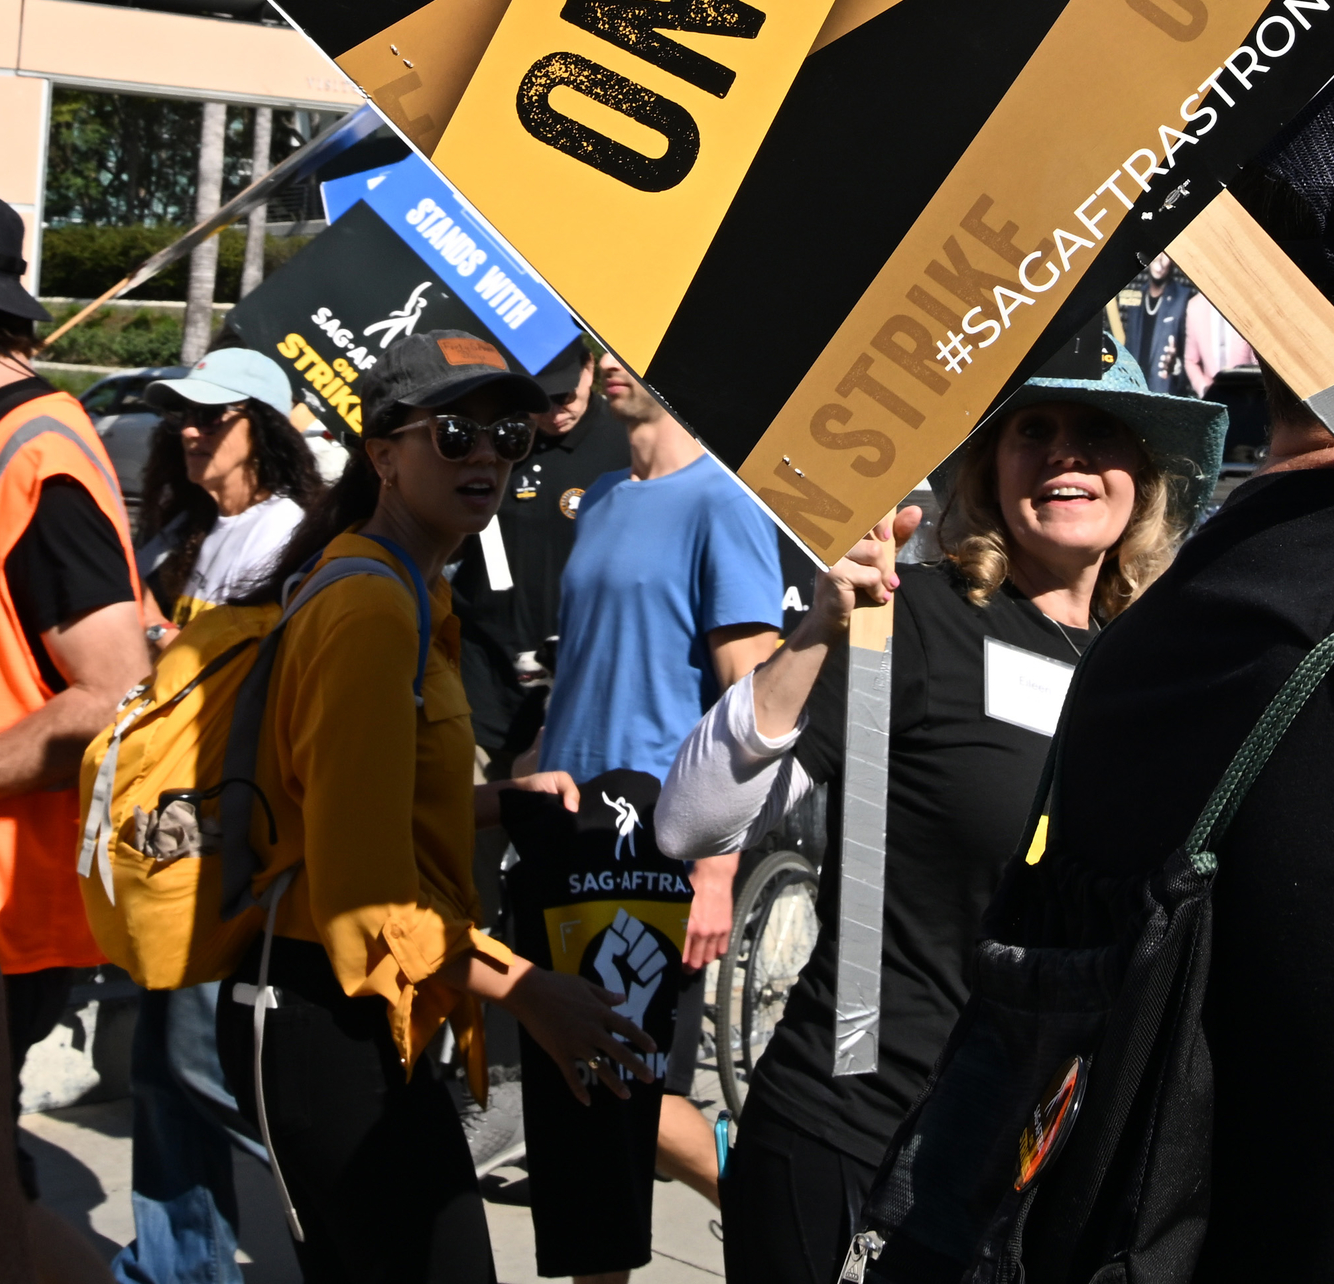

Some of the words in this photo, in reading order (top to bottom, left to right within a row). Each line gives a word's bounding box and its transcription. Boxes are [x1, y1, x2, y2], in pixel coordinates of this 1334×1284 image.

[405, 198, 488, 277] STANDS
[474, 265, 537, 330] WITH
[332, 357, 359, 383] ON
[809, 192, 1057, 478] STRIKE
